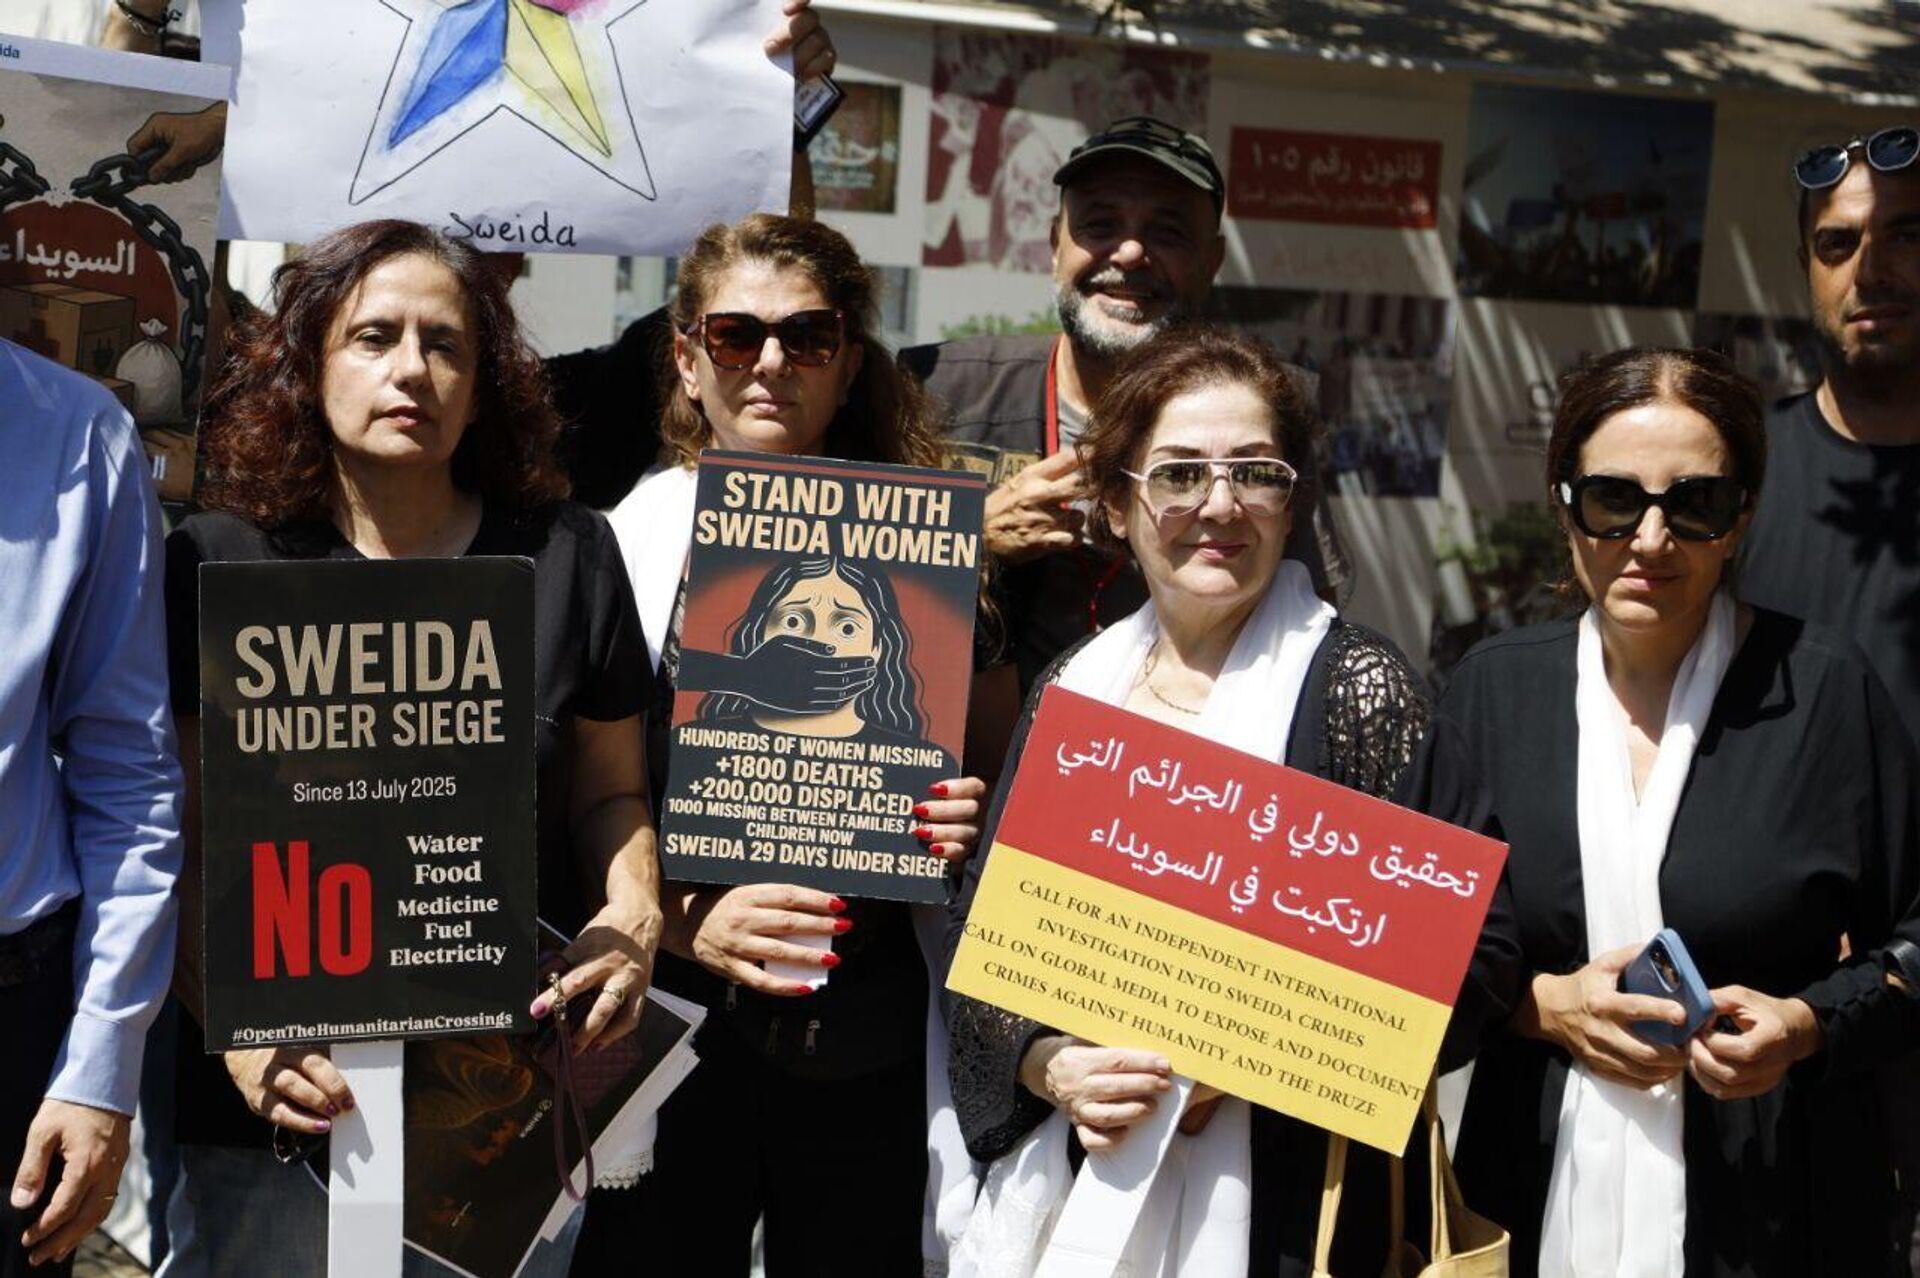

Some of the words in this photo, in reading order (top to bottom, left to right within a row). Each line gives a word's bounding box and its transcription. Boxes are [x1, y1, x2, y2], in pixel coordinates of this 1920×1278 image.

[442, 211, 577, 247] Sweida
[0, 228, 136, 279] السويداء
[724, 471, 844, 516] STAND
[856, 482, 951, 527] WITH
[695, 509, 830, 555] SWEIDA
[841, 522, 977, 568] WOMEN
[235, 619, 502, 698] SWEIDA
[236, 704, 376, 752] UNDER
[392, 699, 505, 746] SIEGE
[679, 728, 769, 753] HUNDREDS
[774, 736, 796, 755] OF
[799, 738, 865, 760] WOMEN
[869, 745, 943, 768] MISSING
[716, 754, 786, 780] +1800
[793, 761, 883, 790] DEATHS
[1056, 737, 1126, 776] التي
[294, 782, 342, 802] Since
[346, 780, 367, 800] 13
[370, 779, 407, 803] July
[411, 776, 456, 797] 2025
[689, 777, 792, 805] +200,000
[798, 786, 914, 816] DISPLACED
[1129, 758, 1243, 815] الجرائم
[669, 799, 704, 815] 1000
[706, 801, 767, 822] MISSING
[770, 808, 836, 827] BETWEEN
[839, 813, 905, 834] FAMILIES
[746, 822, 816, 842] CHILDREN
[819, 828, 855, 846] NOW
[1248, 793, 1279, 842] في
[1288, 811, 1359, 858] دولي
[406, 835, 483, 855] Water
[665, 833, 745, 860] SWEIDA
[750, 841, 774, 862] 29
[779, 844, 828, 868] DAYS
[831, 849, 893, 874] UNDER
[1090, 817, 1224, 886] السويداء
[414, 861, 482, 884] Food
[1229, 865, 1260, 914] في
[1369, 844, 1479, 899] تحقيق
[252, 840, 372, 979] No
[398, 895, 499, 916] Medicine
[1272, 886, 1387, 948] ارتكبت
[425, 921, 472, 940] Fuel
[389, 944, 507, 966] Electricity
[1019, 879, 1063, 906] CALL
[1067, 897, 1102, 920] FOR
[1105, 912, 1132, 930] AN
[1134, 921, 1261, 977] INDEPENDENT
[1264, 968, 1408, 1033] INTERNATIONAL
[1036, 917, 1174, 978] INVESTIGATION
[1177, 968, 1222, 995] INTO
[1225, 987, 1293, 1022] SWEIDA
[1299, 1014, 1366, 1048] CRIMES
[232, 1011, 513, 1044] #OpenTheHumanitarianCrossings
[963, 922, 1006, 948] CALL
[1010, 939, 1038, 959] ON
[1041, 951, 1108, 985] GLOBAL
[1112, 976, 1169, 1008] MEDIA
[1175, 998, 1200, 1019] TO
[1203, 1010, 1270, 1046] EXPOSE
[1274, 1038, 1314, 1060] AND
[1317, 1052, 1425, 1102] DOCUMENT
[984, 961, 1049, 994] CRIMES
[1051, 987, 1129, 1023] AGAINST
[1132, 1015, 1230, 1062] HUMANITY
[1232, 1054, 1273, 1078] AND
[1278, 1069, 1314, 1093] THE
[1318, 1084, 1378, 1118] DRUZE
